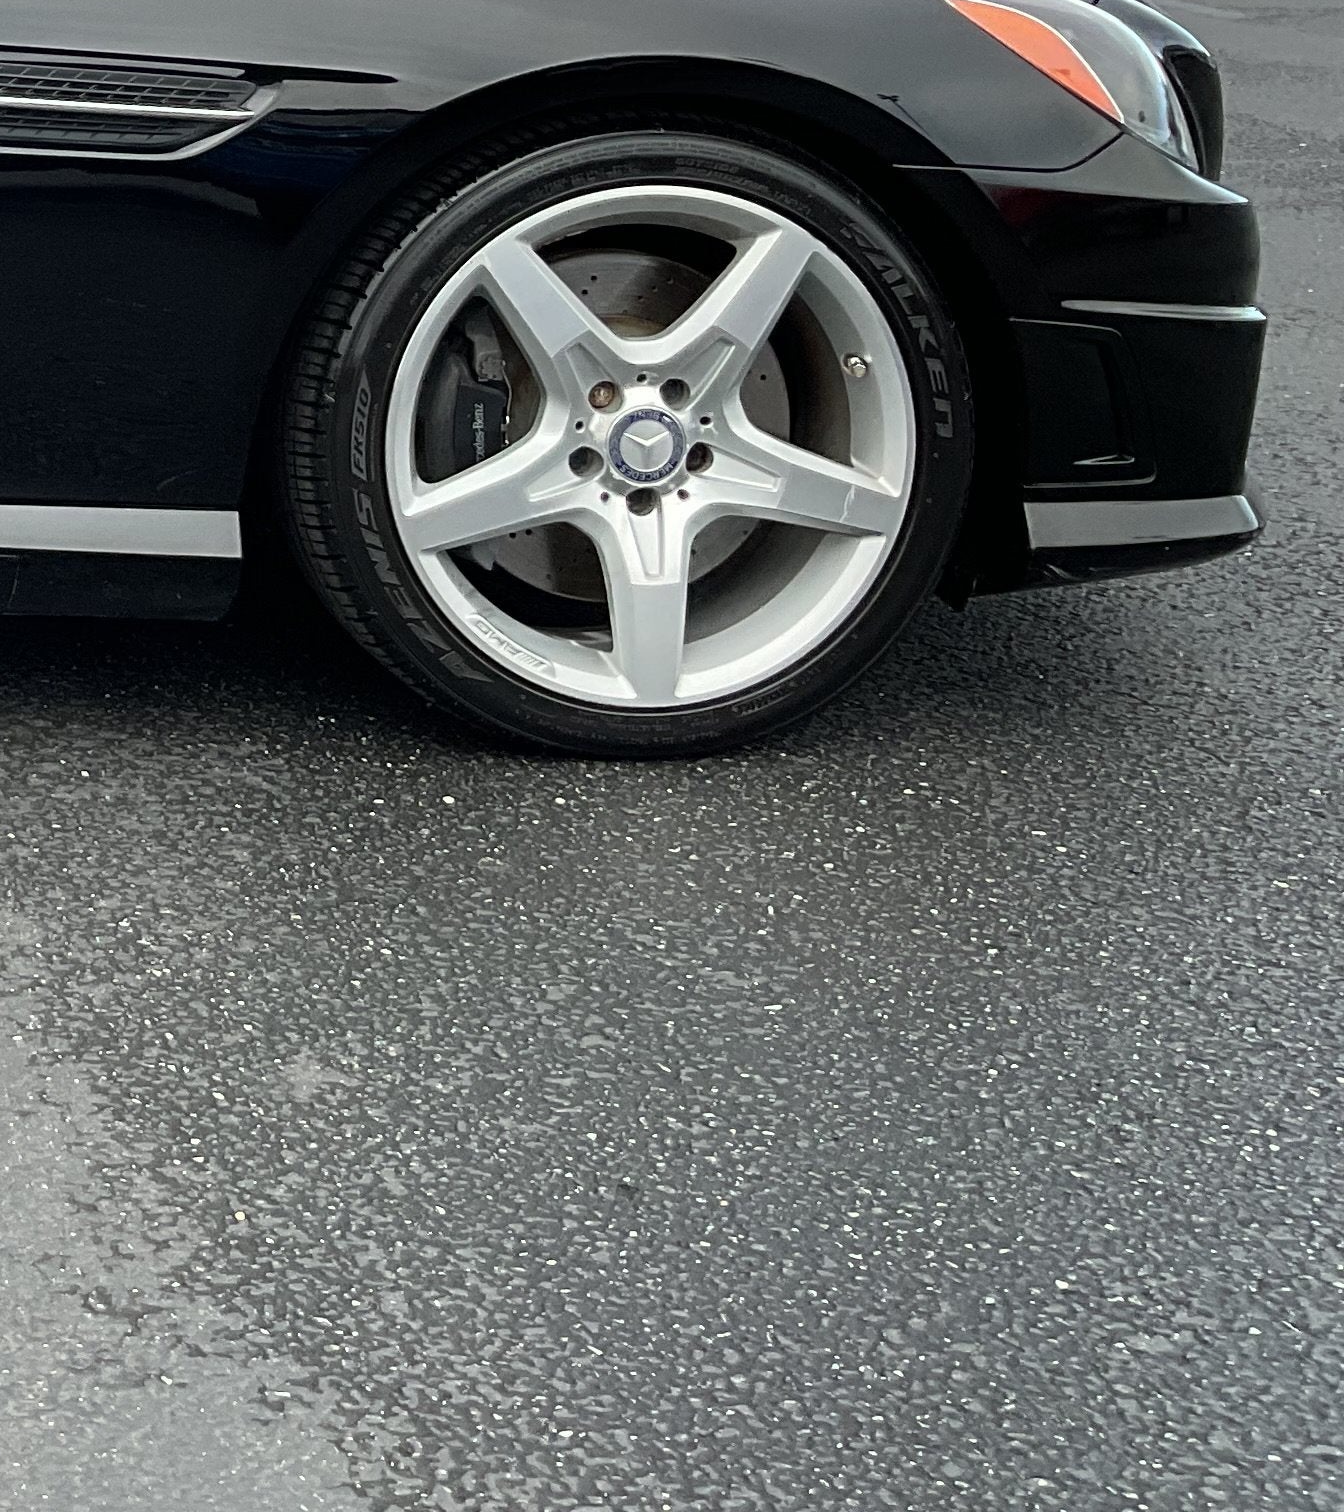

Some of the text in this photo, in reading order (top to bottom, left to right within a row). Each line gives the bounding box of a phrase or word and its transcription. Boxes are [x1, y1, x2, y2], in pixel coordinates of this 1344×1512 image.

[839, 219, 955, 440] FALKEN
[620, 461, 674, 481] MERCEDES
[355, 488, 494, 683] AZENIS
